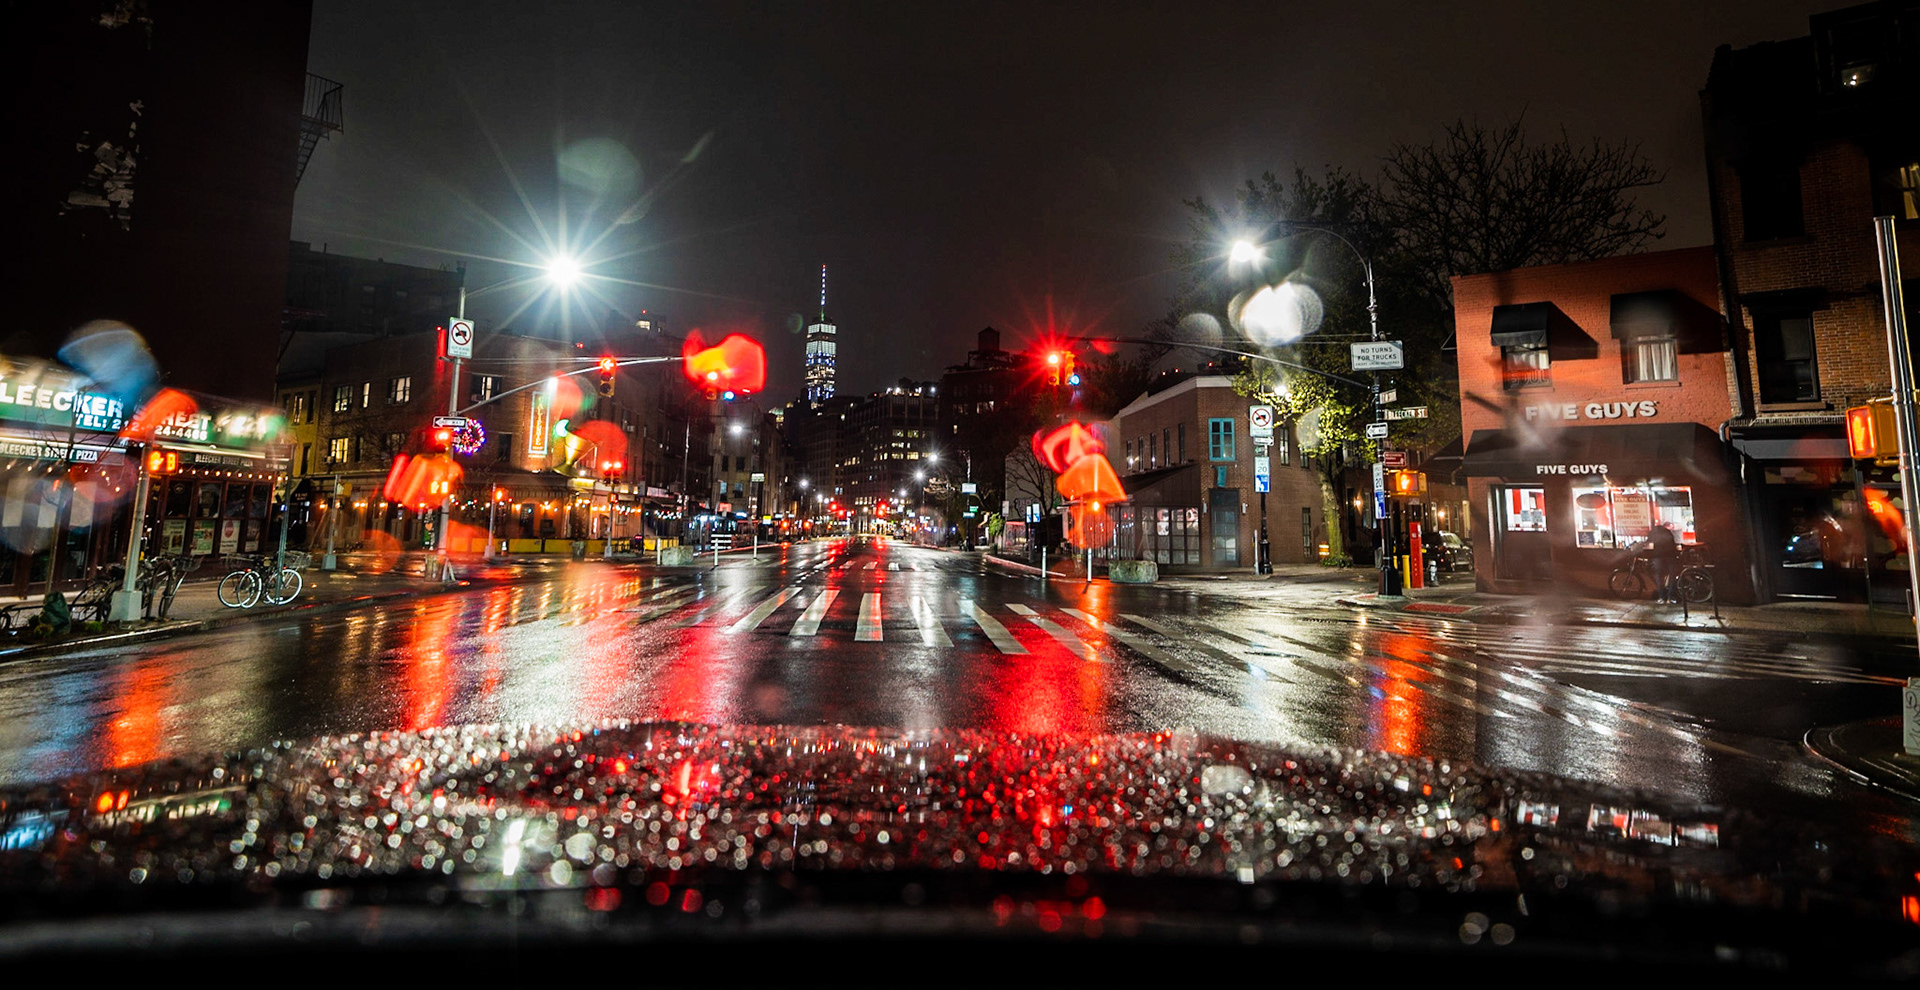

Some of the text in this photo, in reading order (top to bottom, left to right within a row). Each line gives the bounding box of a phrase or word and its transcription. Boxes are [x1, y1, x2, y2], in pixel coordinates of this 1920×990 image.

[1418, 409, 1425, 418] ST
[1525, 401, 1656, 421] FIVE GUYS
[76, 414, 107, 429] TEL:
[76, 450, 98, 461] PIZZA
[195, 454, 221, 464] BLEECKER
[1536, 464, 1608, 475] FIVE GUYS
